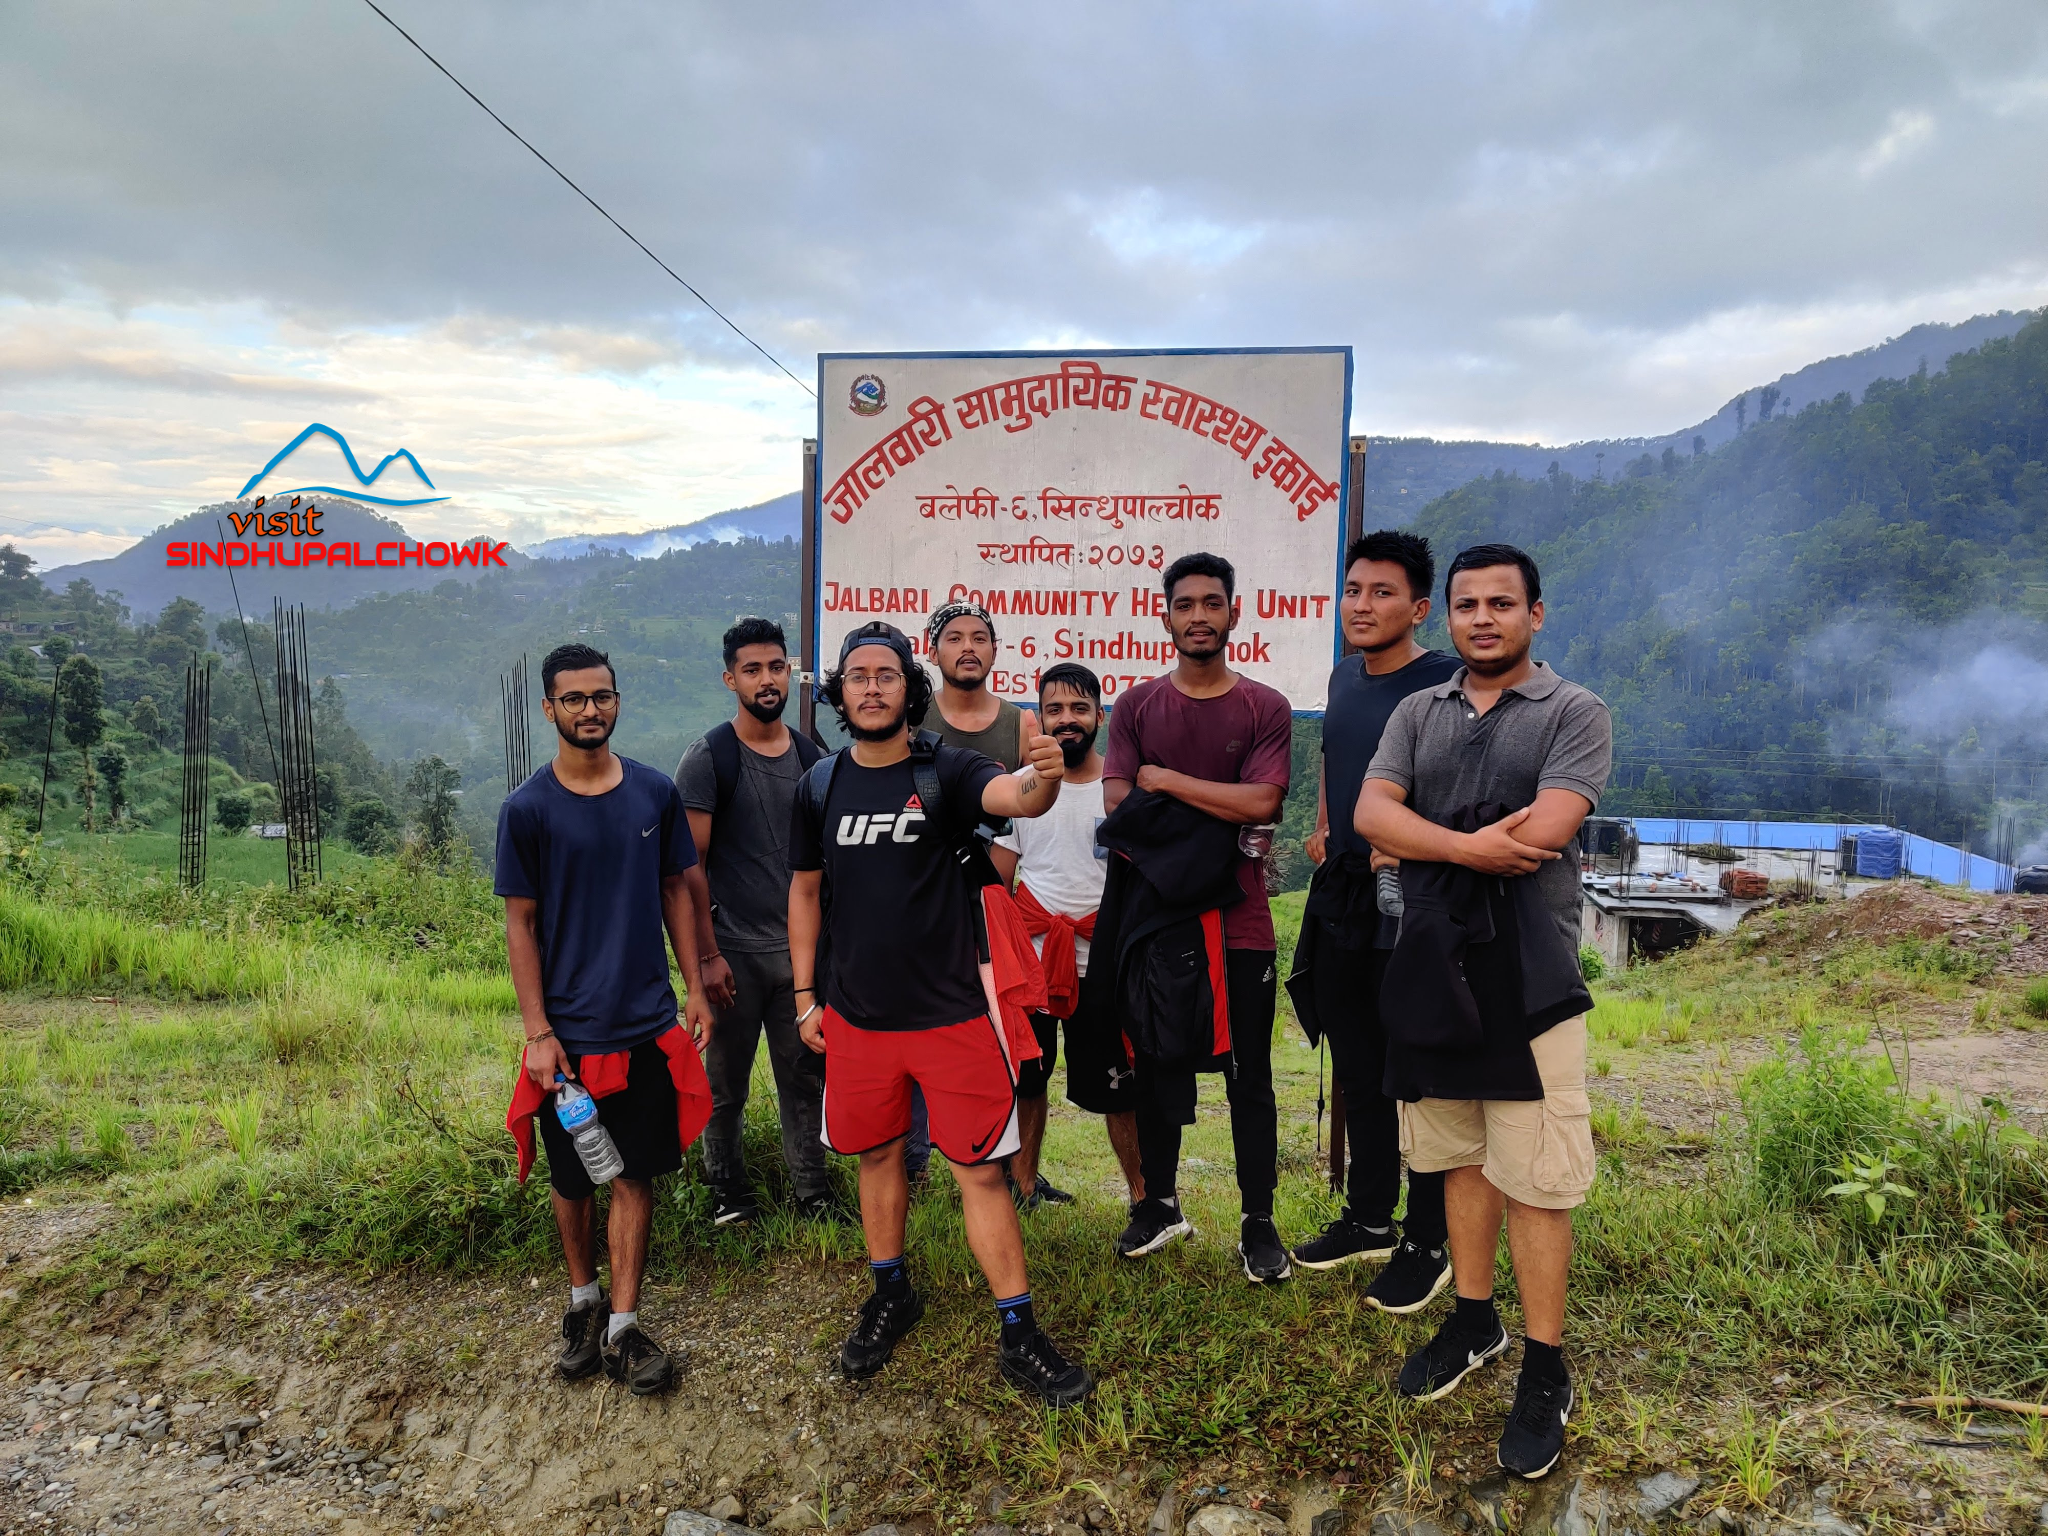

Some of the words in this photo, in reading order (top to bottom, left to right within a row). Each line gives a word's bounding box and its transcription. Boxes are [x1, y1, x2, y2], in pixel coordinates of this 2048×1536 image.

[953, 360, 1138, 433] सामुदायिक
[1252, 436, 1341, 522] इकाई
[825, 581, 929, 613] JALBARI
[949, 583, 1120, 617] COMMUNITY
[1257, 589, 1330, 619] UNIT
[836, 812, 926, 846] UFC
